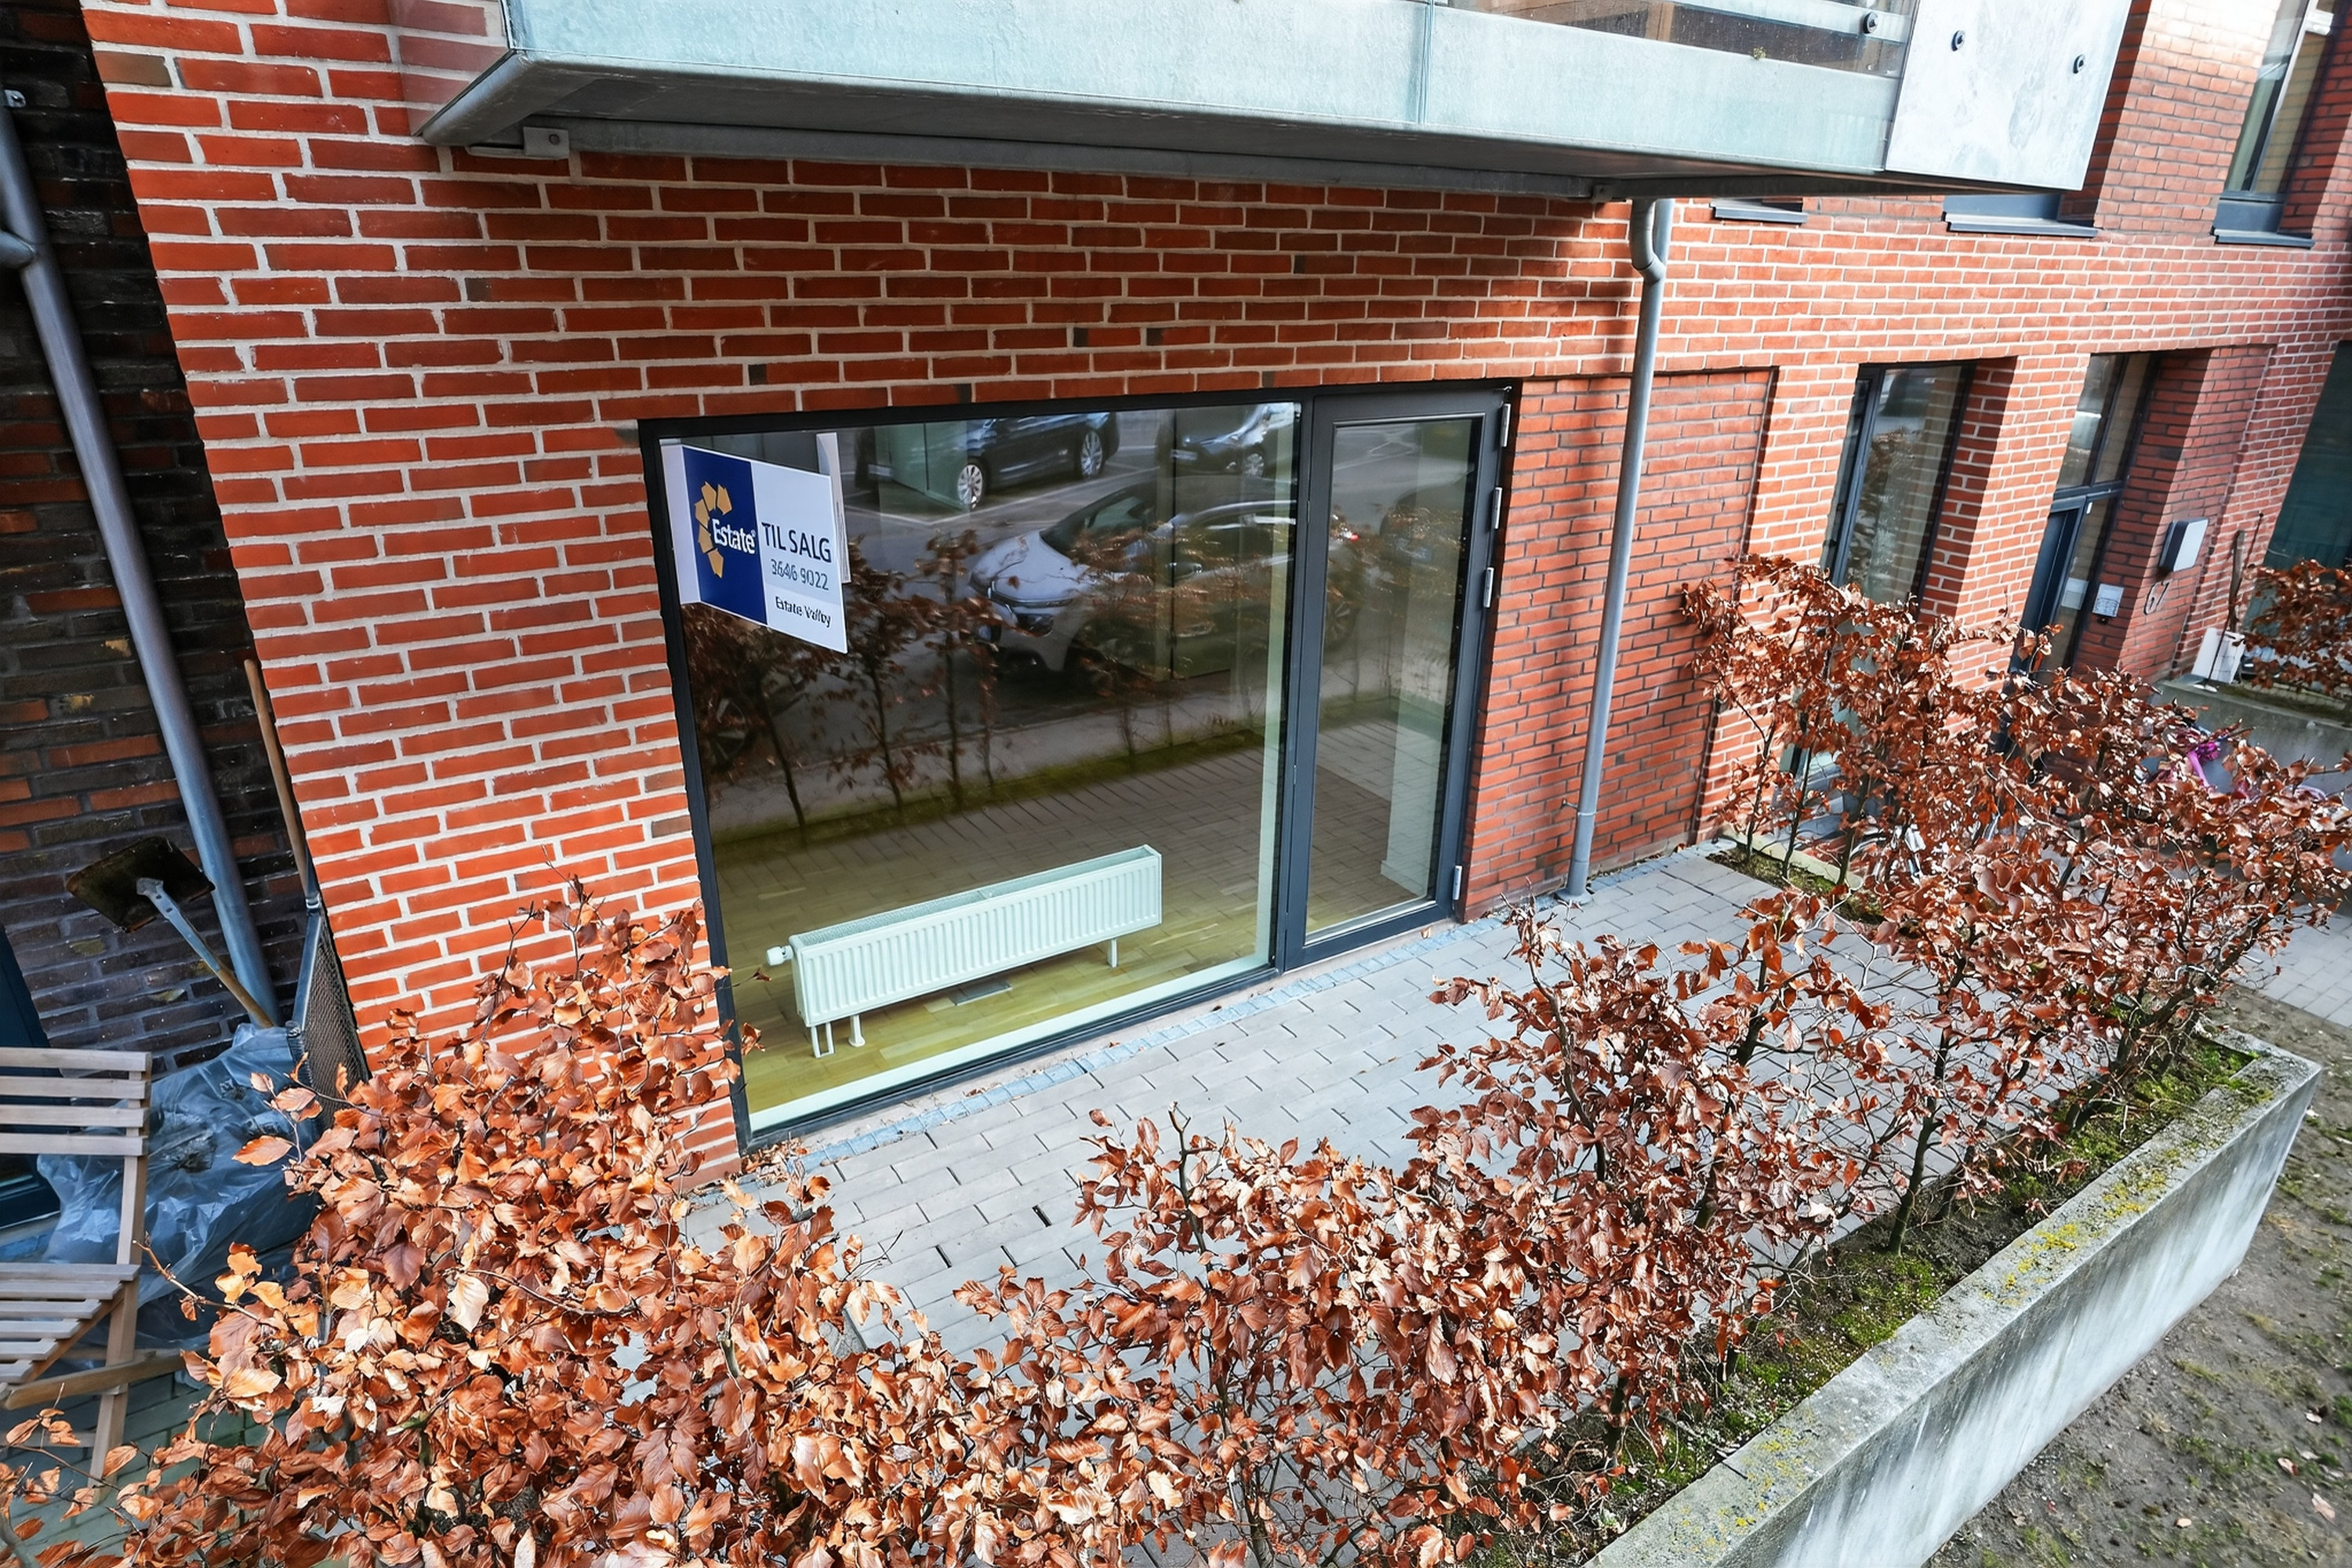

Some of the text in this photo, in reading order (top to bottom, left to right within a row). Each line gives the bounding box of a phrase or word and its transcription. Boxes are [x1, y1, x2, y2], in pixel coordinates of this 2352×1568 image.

[712, 518, 755, 554] Estate
[761, 521, 832, 563] TIL SALG
[771, 558, 829, 590] 3646 9022
[775, 596, 803, 616] Estate
[2143, 580, 2171, 615] 67
